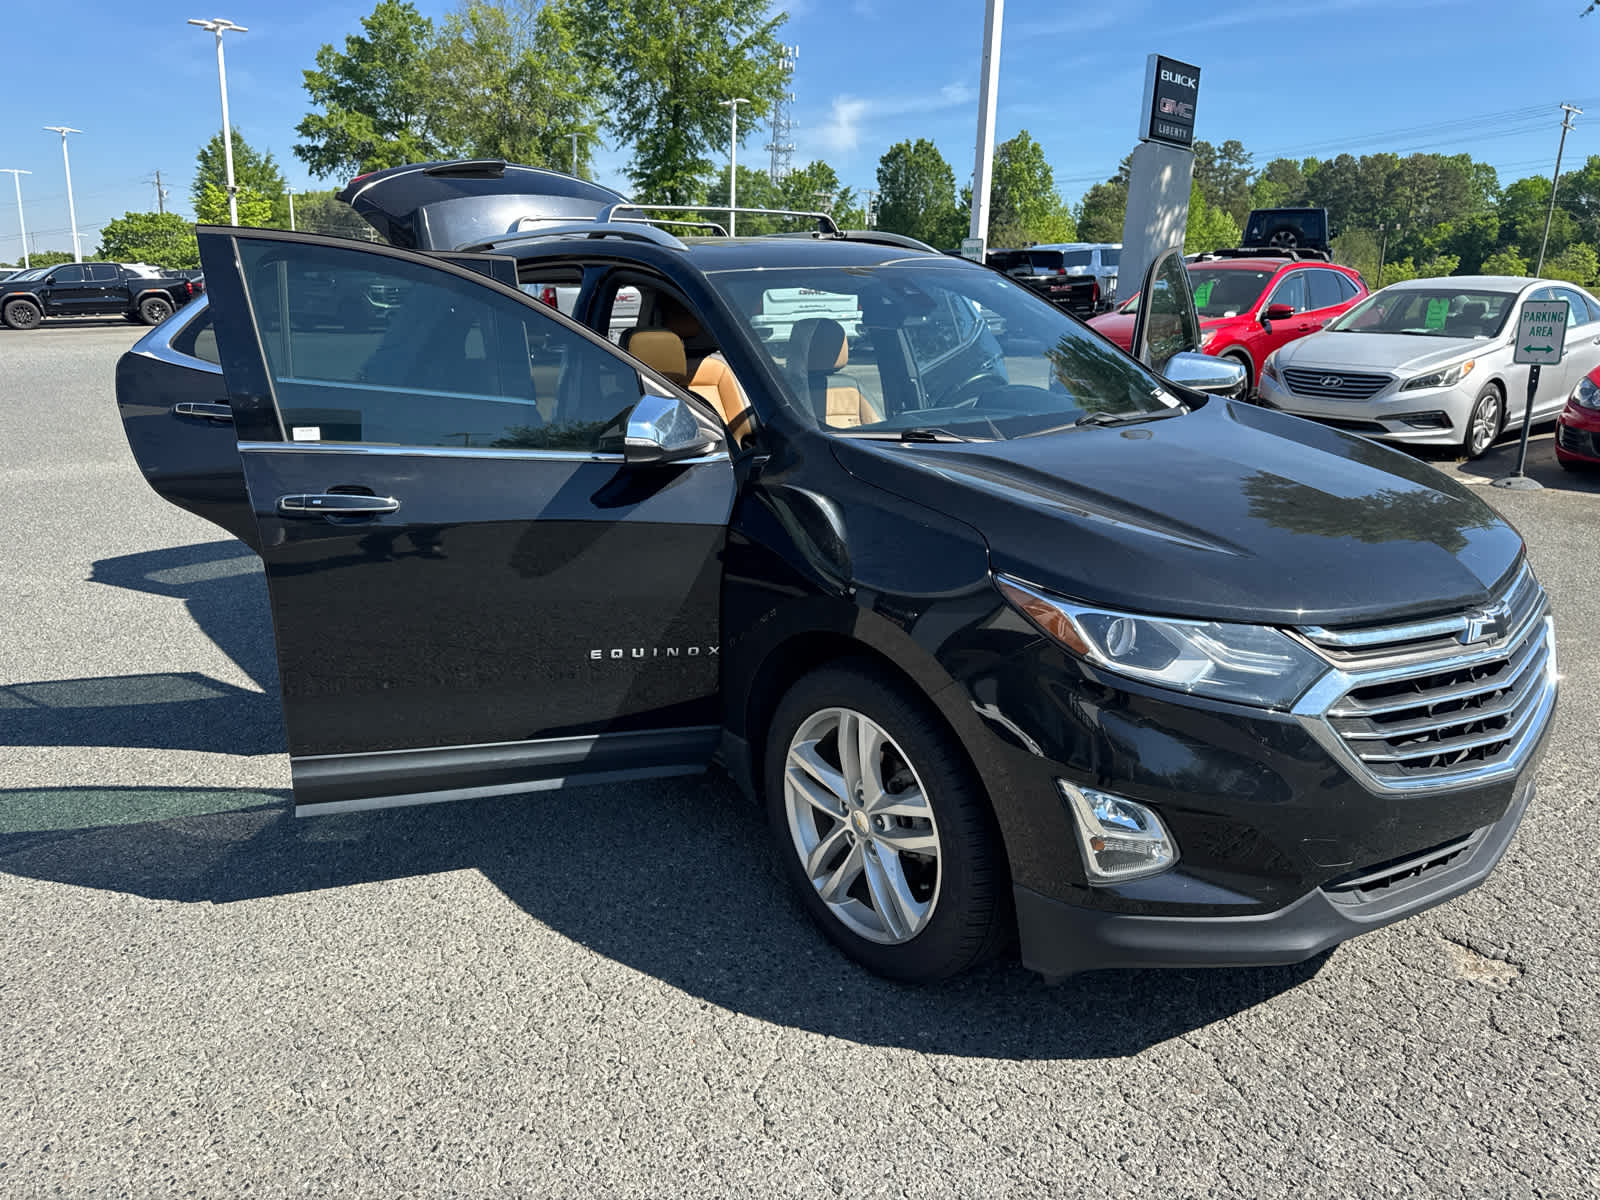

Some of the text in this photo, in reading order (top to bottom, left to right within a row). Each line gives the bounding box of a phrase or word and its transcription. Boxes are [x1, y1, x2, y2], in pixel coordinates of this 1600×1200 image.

[1160, 69, 1197, 89] BUICK
[1159, 97, 1194, 119] GMC
[1158, 123, 1188, 138] LIBERTY
[1523, 311, 1564, 323] PARKING
[1528, 326, 1553, 337] AREA
[590, 646, 720, 660] EQUINOX
